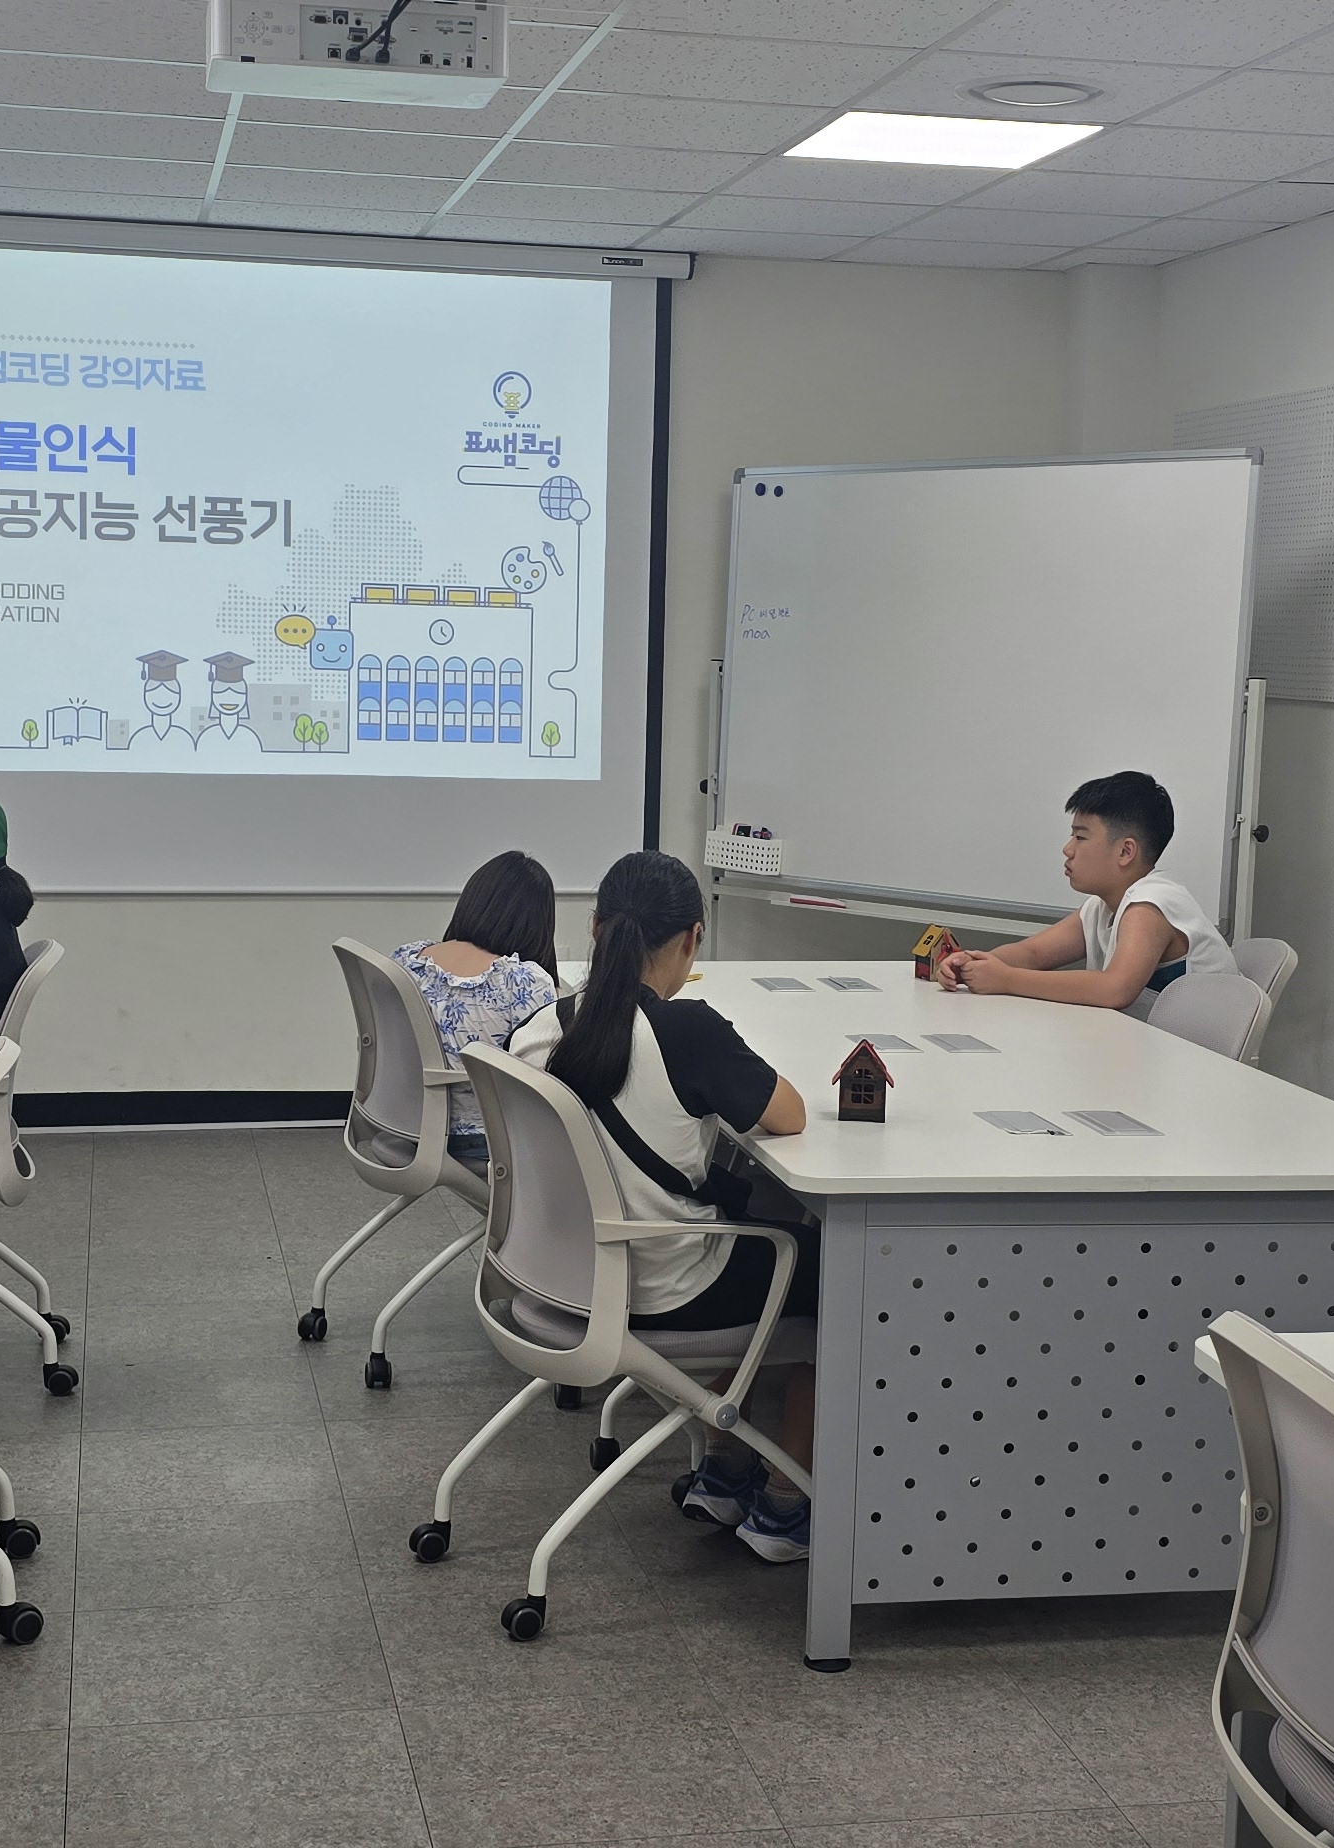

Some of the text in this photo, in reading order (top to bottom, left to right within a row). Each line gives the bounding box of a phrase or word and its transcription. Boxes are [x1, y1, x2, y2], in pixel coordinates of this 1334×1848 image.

[78, 354, 206, 391] 강의자료
[463, 430, 561, 469] 표쌤코딩
[152, 495, 292, 548] 선풍기
